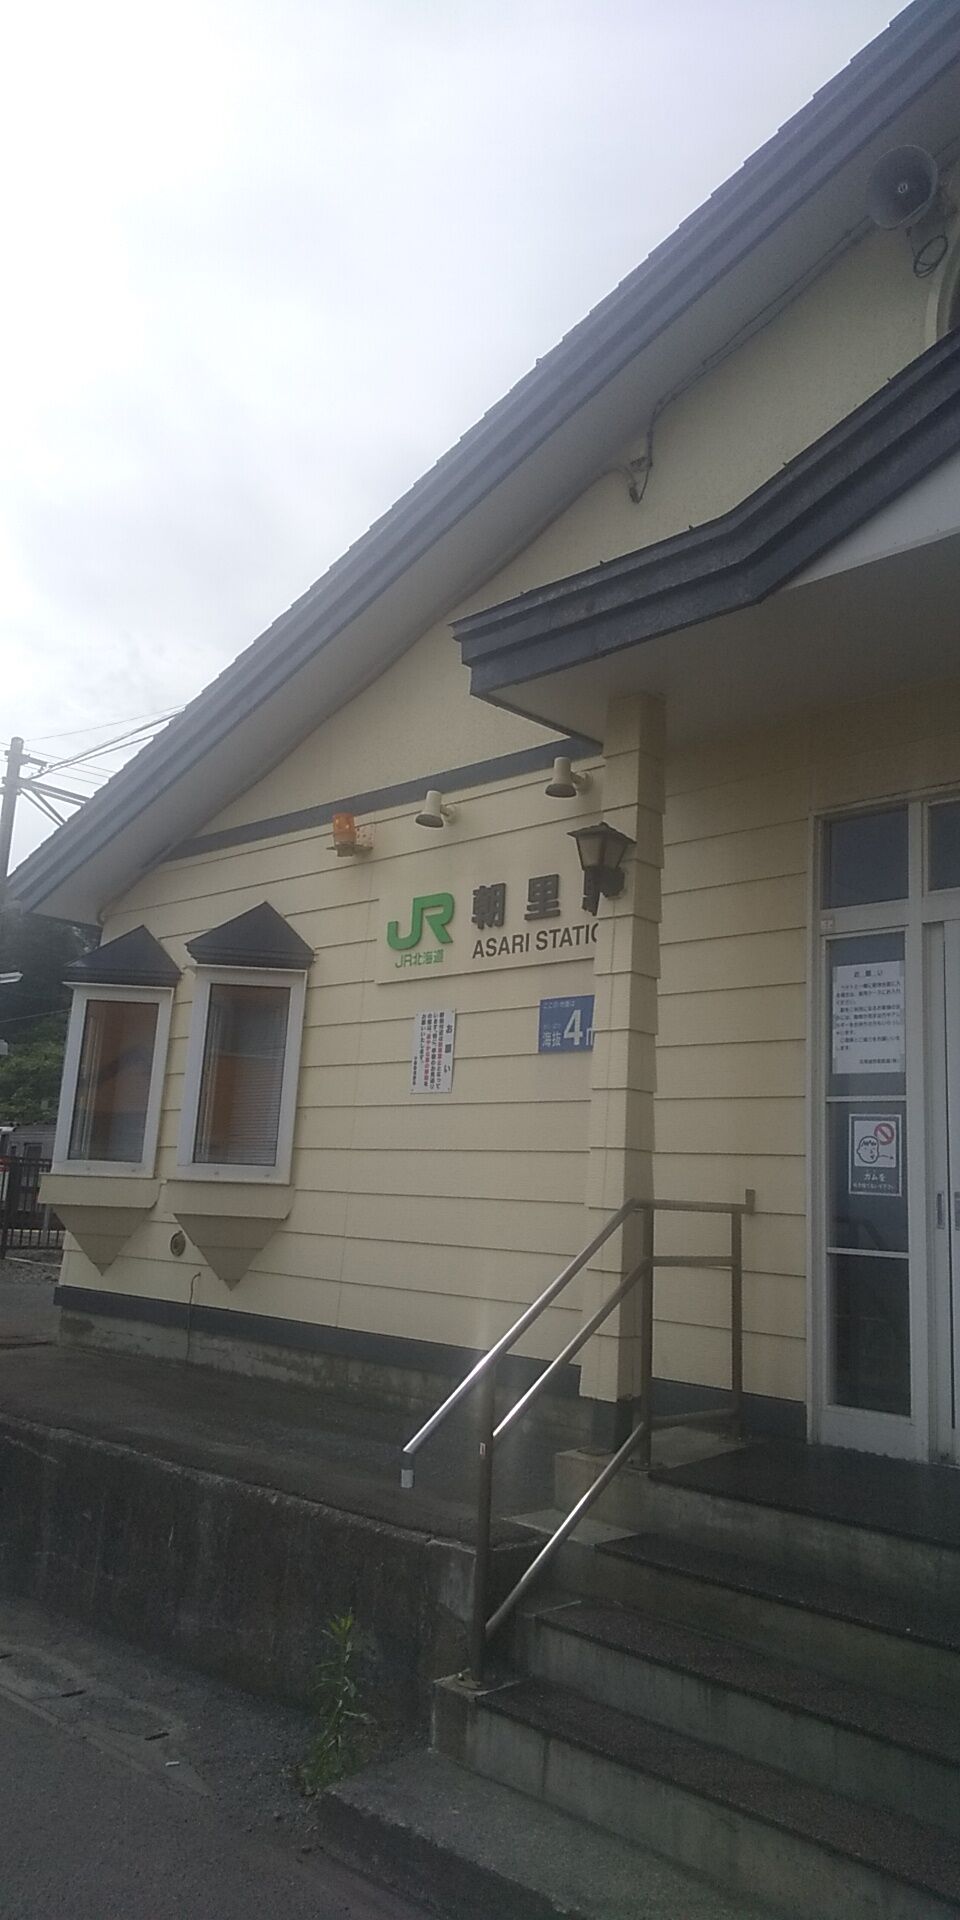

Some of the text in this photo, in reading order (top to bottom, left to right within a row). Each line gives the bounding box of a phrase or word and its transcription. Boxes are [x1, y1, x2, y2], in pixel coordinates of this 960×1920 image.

[387, 893, 455, 951] JR
[395, 949, 444, 968] JR北海道
[472, 933, 529, 959] ASARI
[444, 1025, 452, 1072] お願い
[544, 1030, 561, 1047] 海抜
